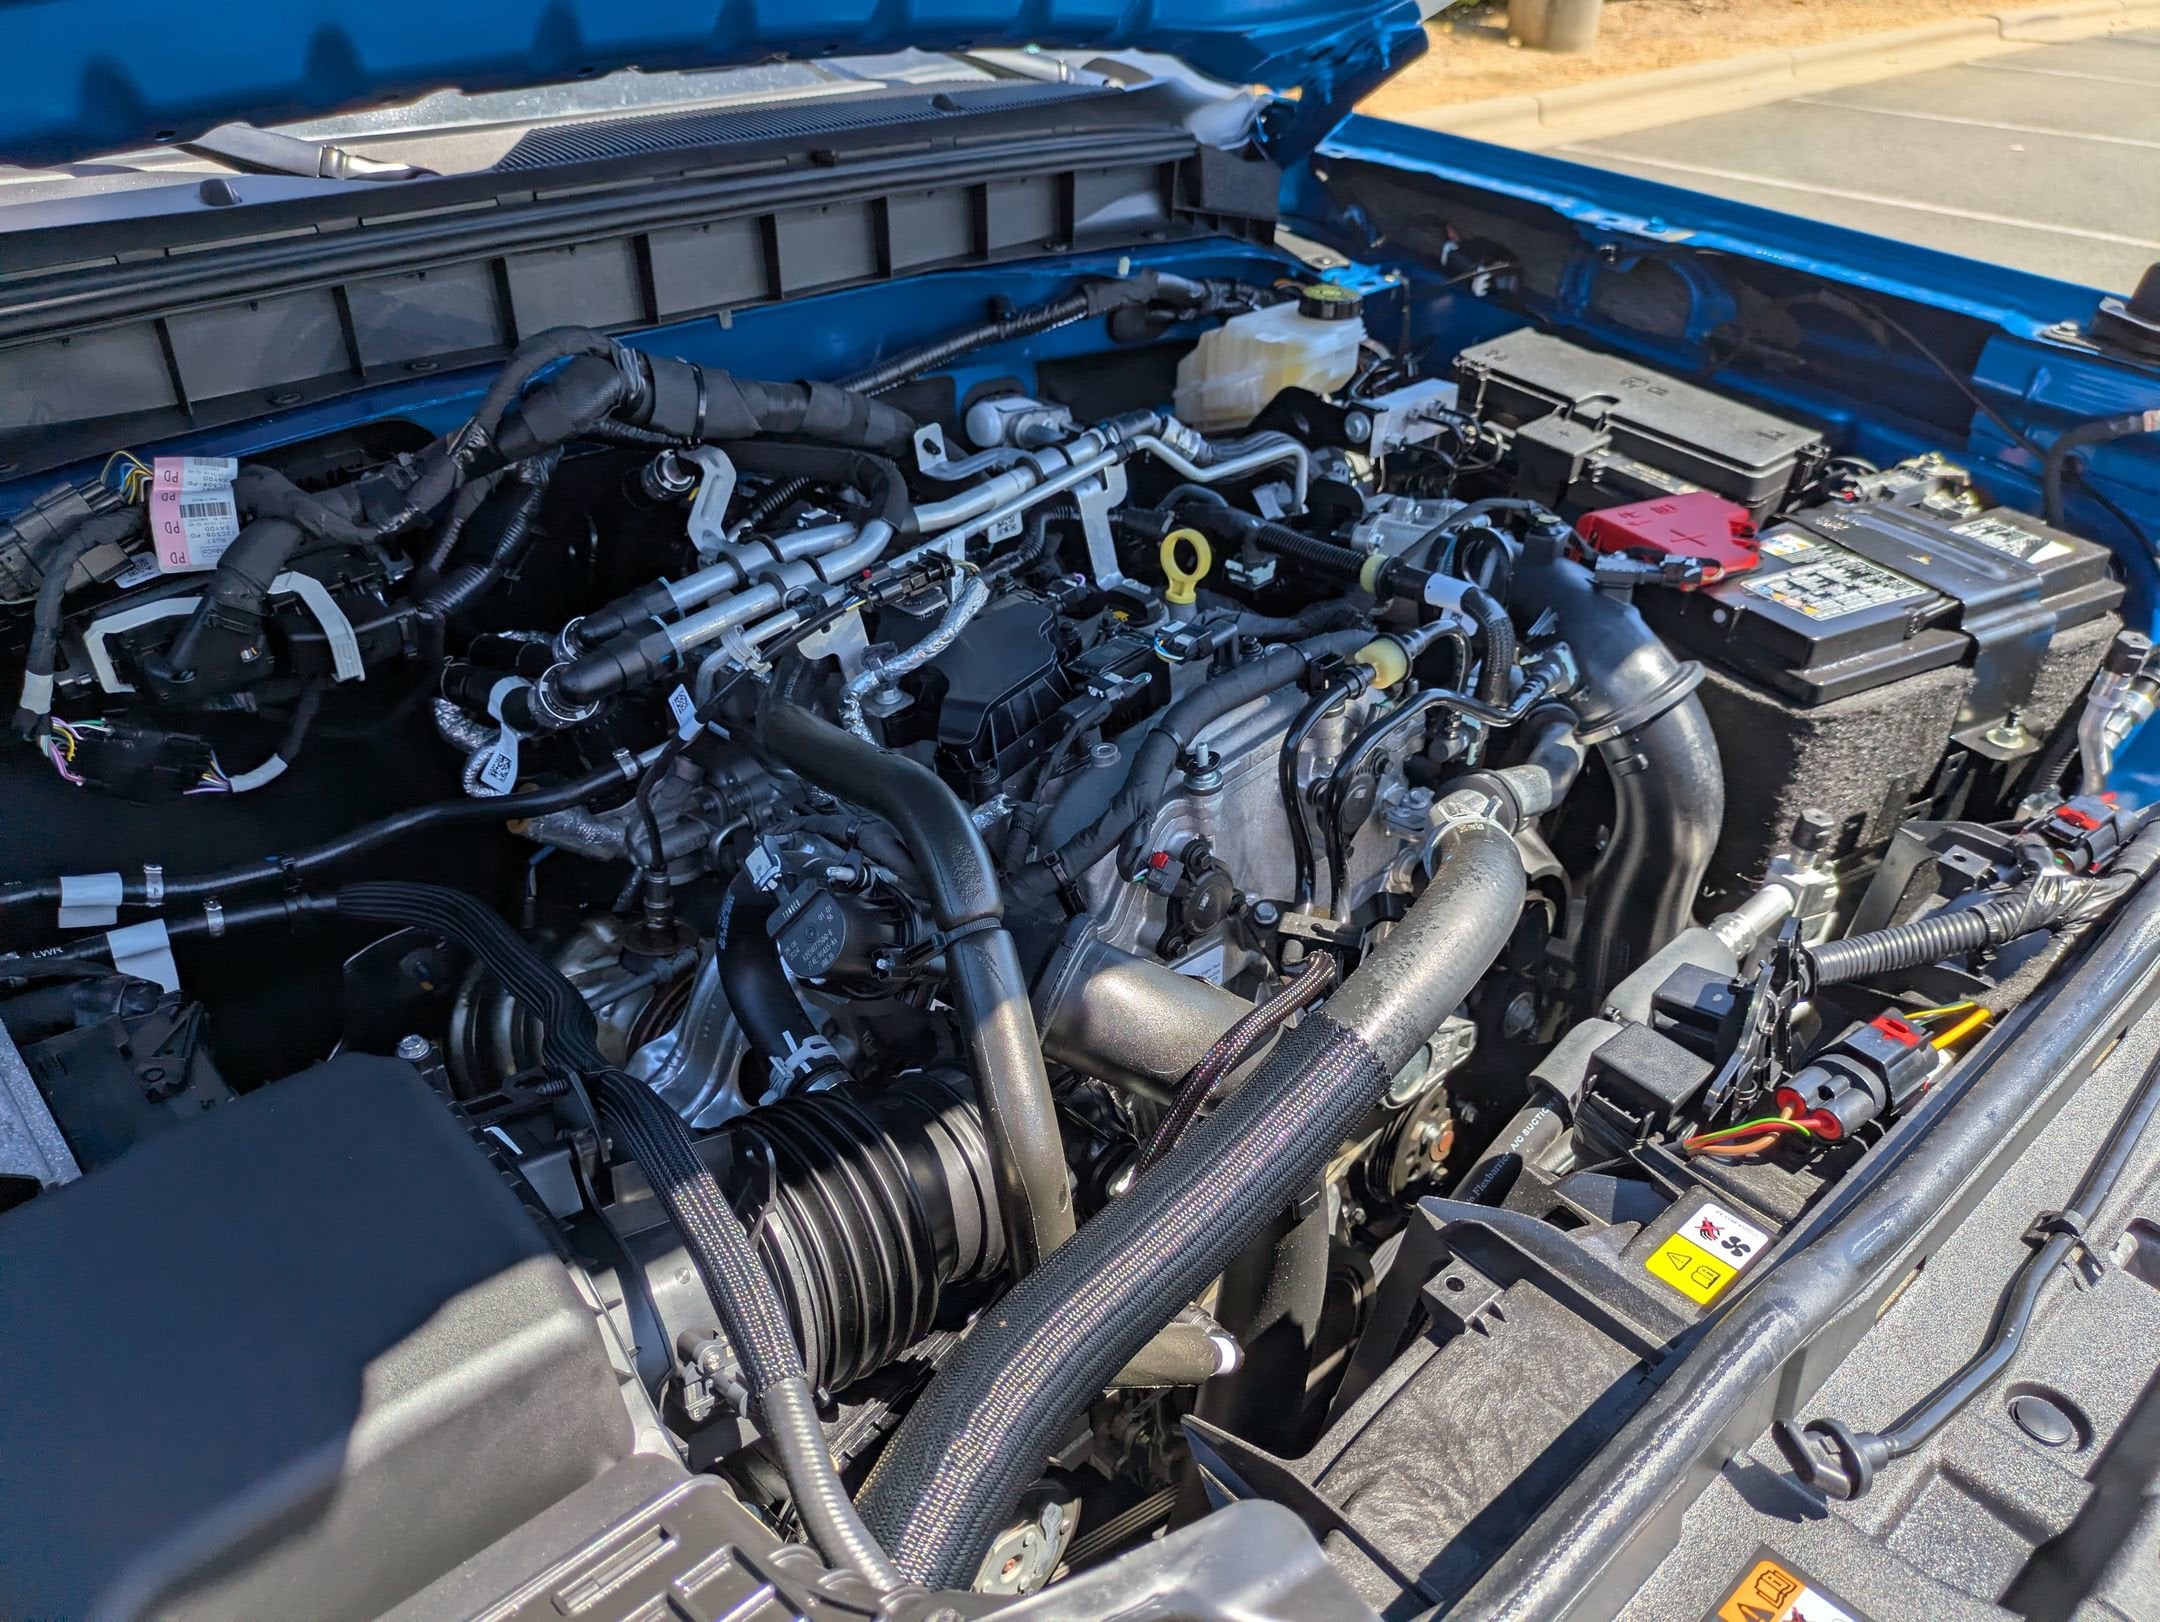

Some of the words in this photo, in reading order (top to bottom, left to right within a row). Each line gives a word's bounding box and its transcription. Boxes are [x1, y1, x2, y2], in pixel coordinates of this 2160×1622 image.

[163, 470, 179, 483] PD
[161, 492, 176, 502] PD
[164, 521, 180, 534] PD
[170, 551, 186, 565] PD
[31, 946, 64, 959] LWR
[1509, 1134, 1525, 1152] A/C
[1522, 1100, 1555, 1137] SUCTION
